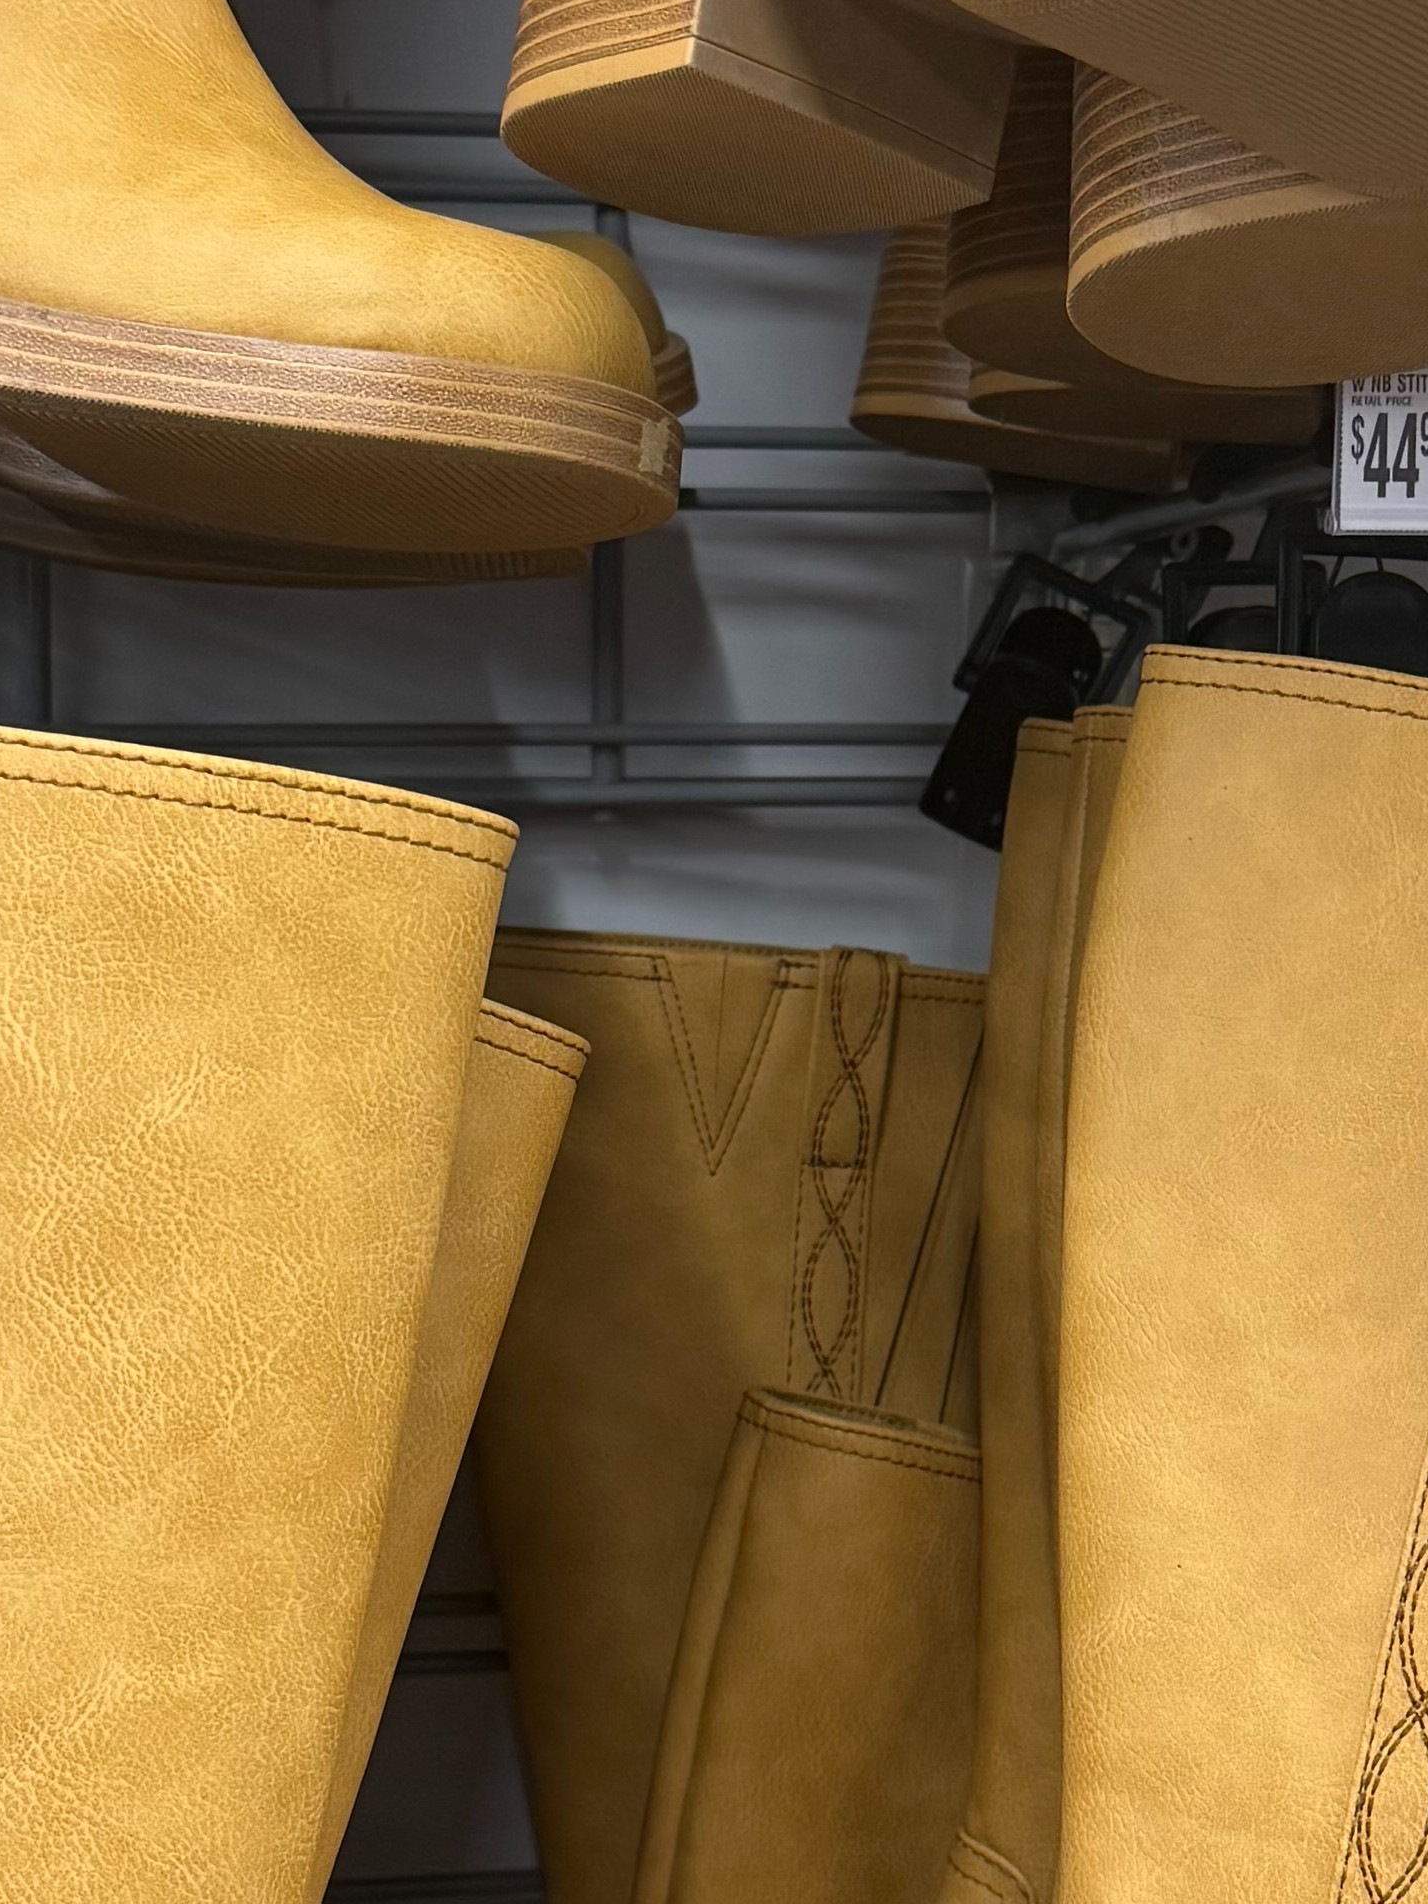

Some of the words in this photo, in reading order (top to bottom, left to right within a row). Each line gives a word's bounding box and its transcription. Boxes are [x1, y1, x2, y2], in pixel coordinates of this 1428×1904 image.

[1351, 377, 1366, 393] W
[1371, 375, 1392, 393] NB
[1351, 396, 1382, 406] RETAIL
[1385, 396, 1413, 407] PRICE
